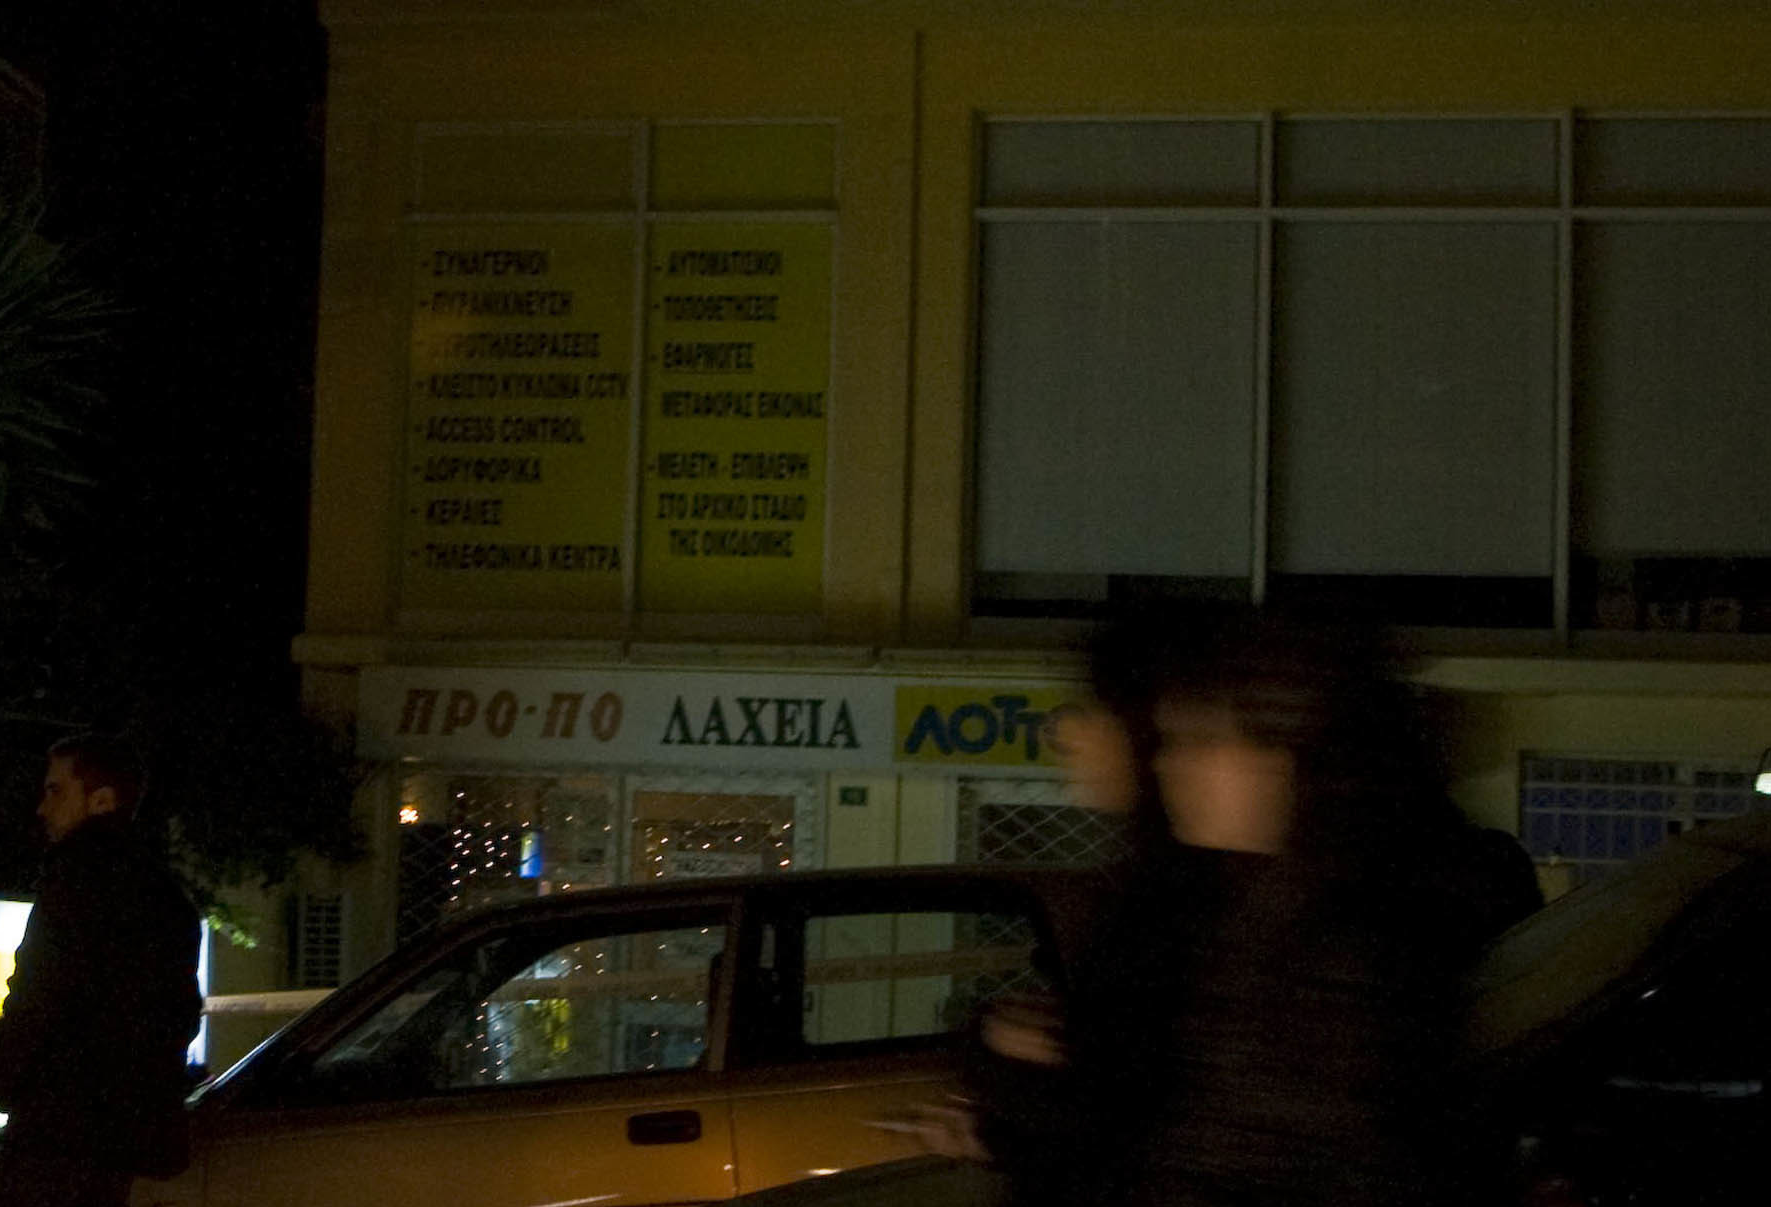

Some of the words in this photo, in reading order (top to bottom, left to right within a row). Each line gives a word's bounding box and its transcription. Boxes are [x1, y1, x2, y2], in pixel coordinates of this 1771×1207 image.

[426, 416, 495, 443] ACCESS
[501, 416, 585, 443] CONTROL
[660, 694, 861, 749] ΛΑΧΕΙΑ
